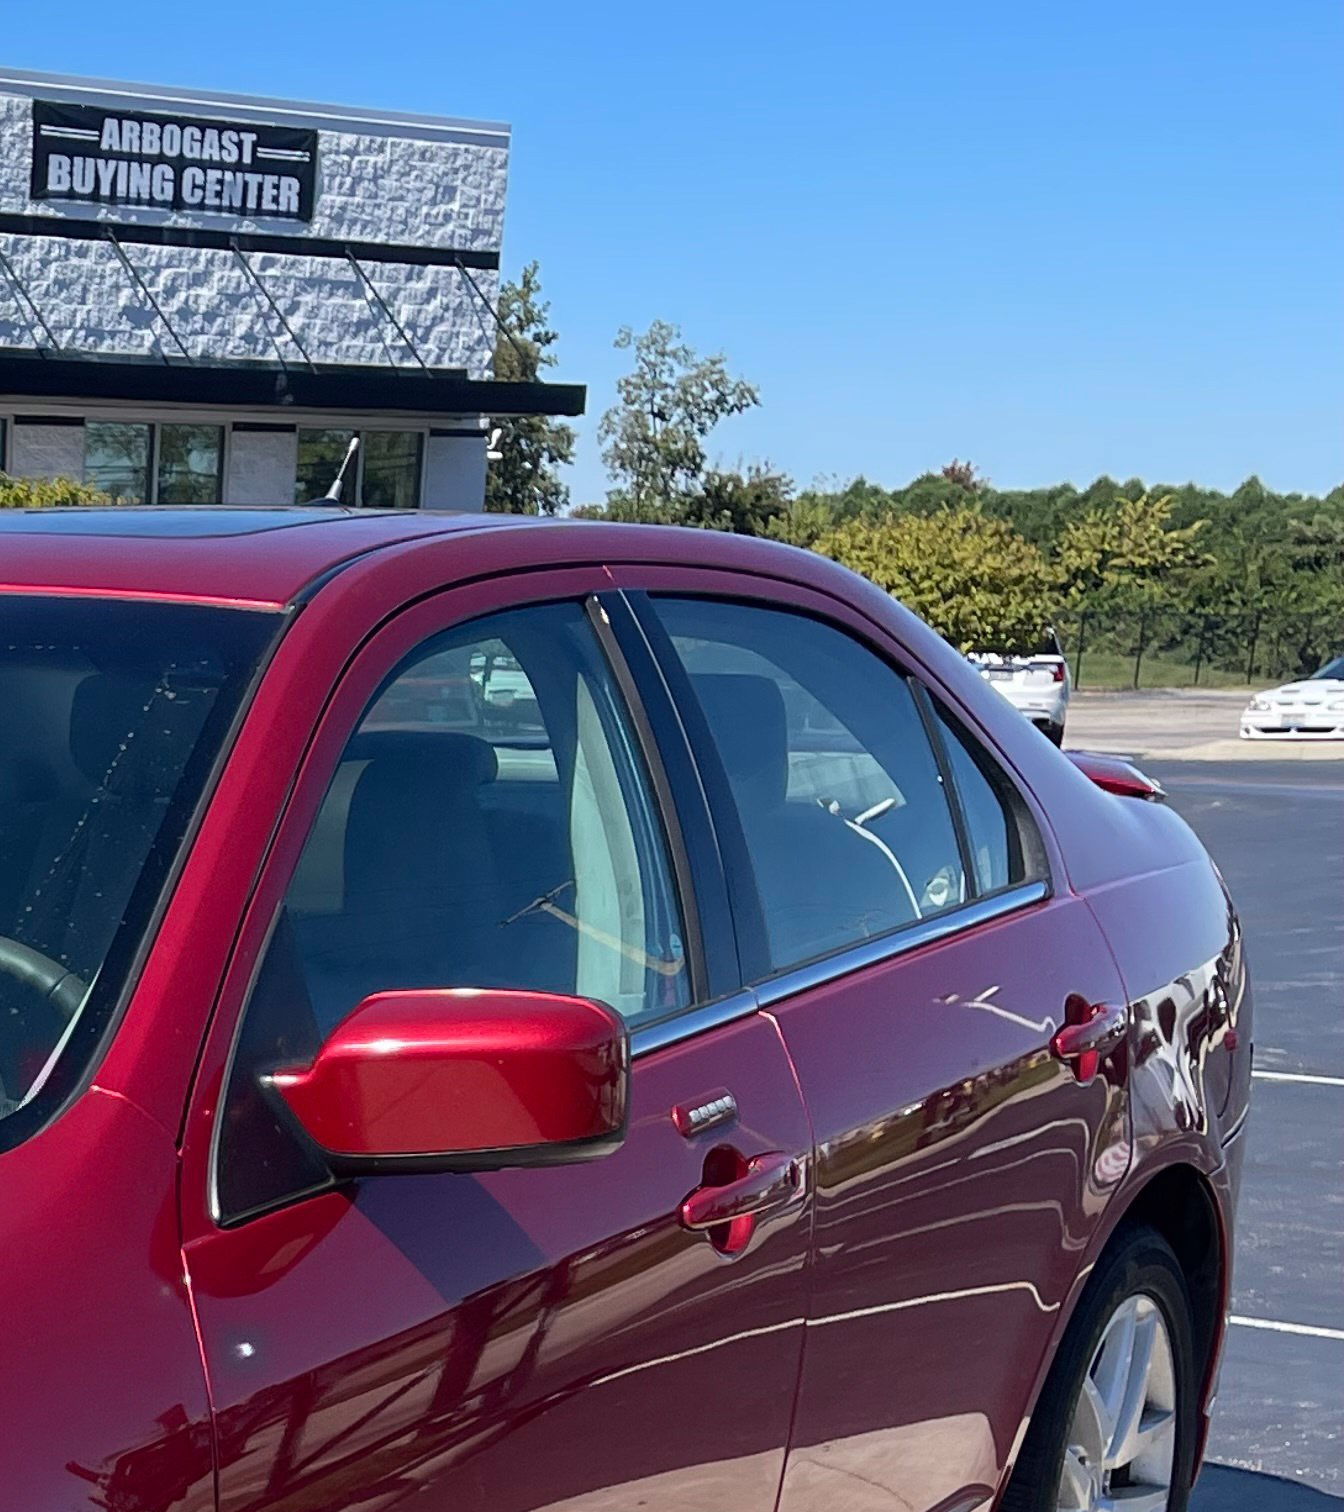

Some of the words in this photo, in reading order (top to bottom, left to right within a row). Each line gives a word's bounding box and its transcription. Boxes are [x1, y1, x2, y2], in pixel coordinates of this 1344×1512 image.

[100, 117, 258, 165] ARBOGAST
[47, 153, 175, 202] BUYING
[181, 166, 301, 213] CENTER
